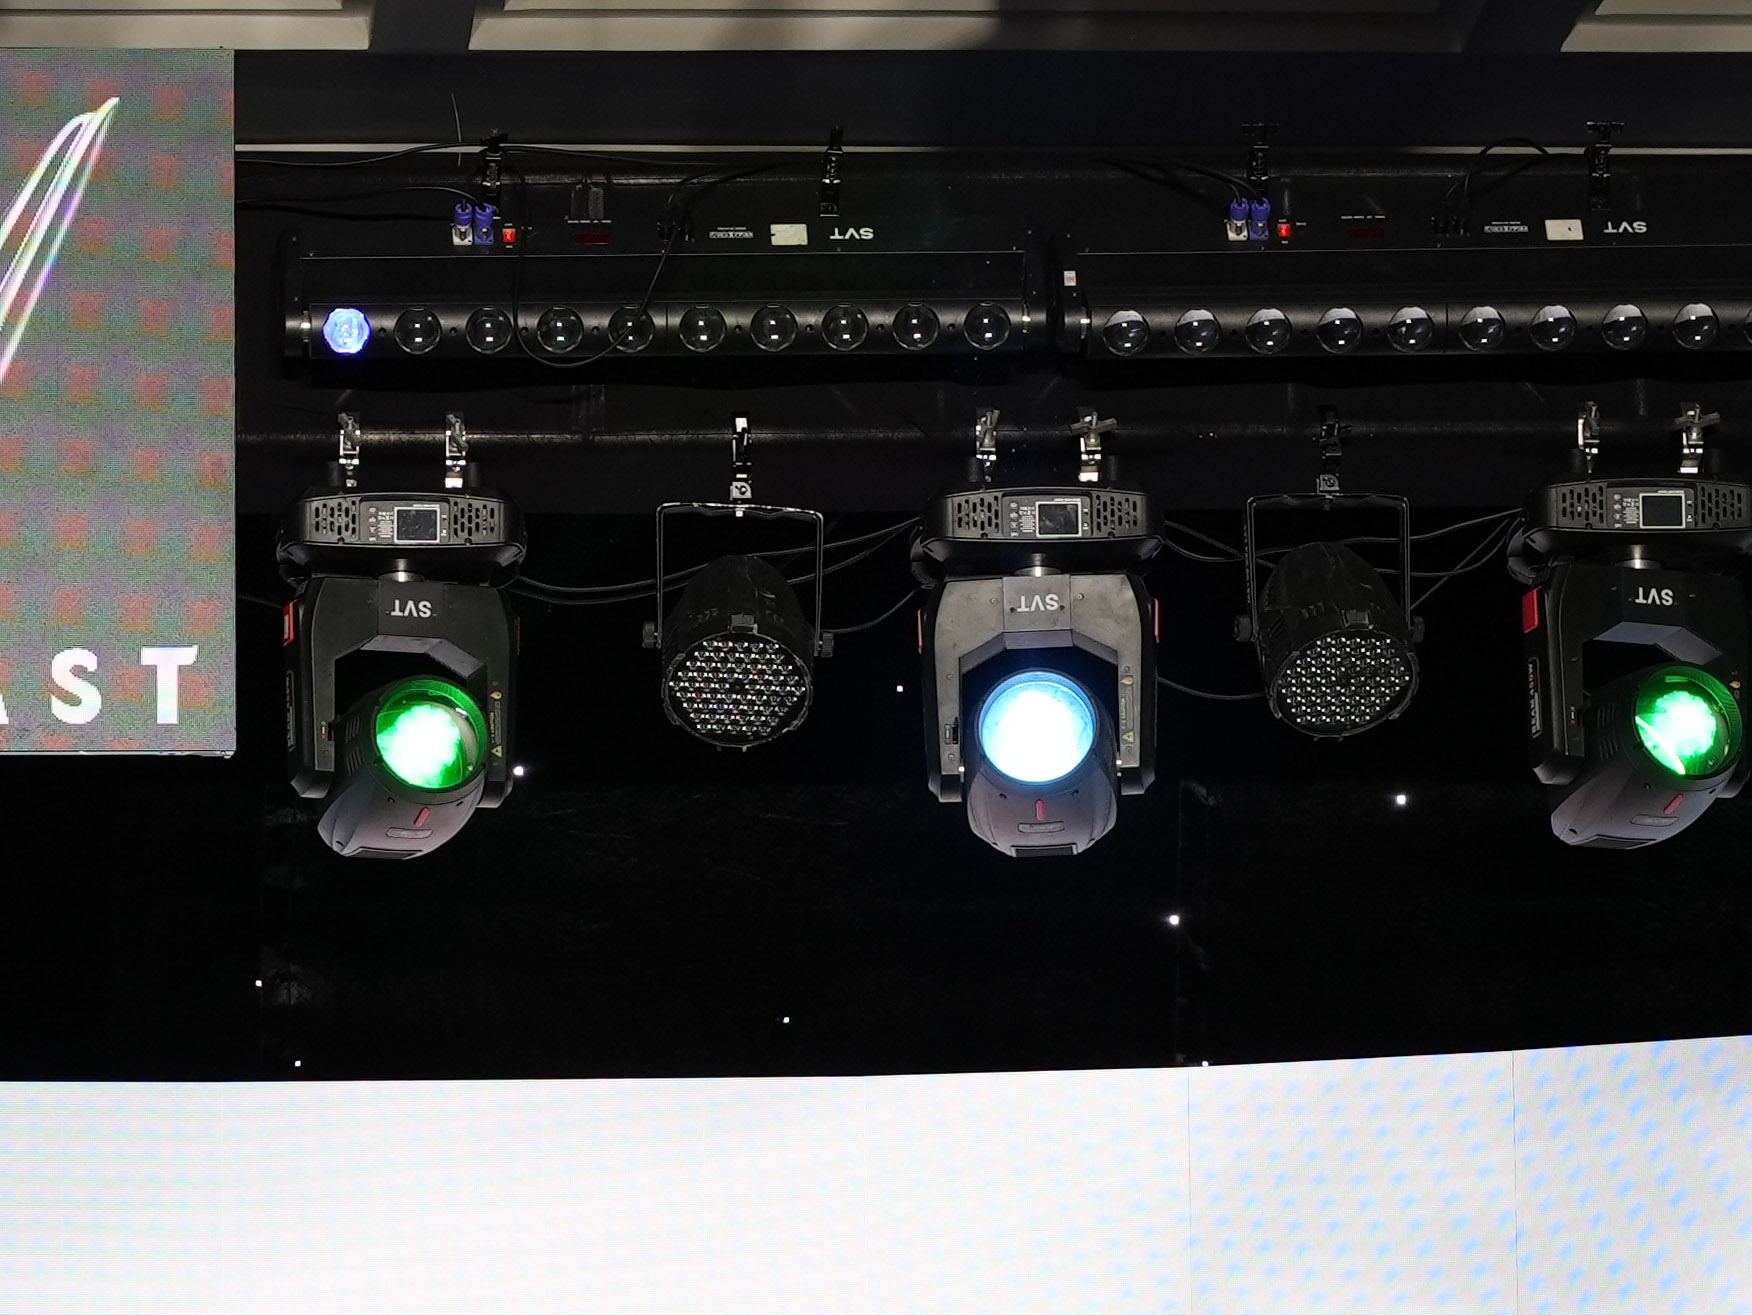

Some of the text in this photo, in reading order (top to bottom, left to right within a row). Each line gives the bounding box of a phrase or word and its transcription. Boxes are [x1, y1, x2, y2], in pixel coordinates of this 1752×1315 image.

[830, 228, 873, 239] SVT
[1604, 222, 1647, 233] SVT
[1017, 594, 1058, 611] SVT
[1635, 587, 1673, 605] SVT
[391, 600, 431, 617] SVT
